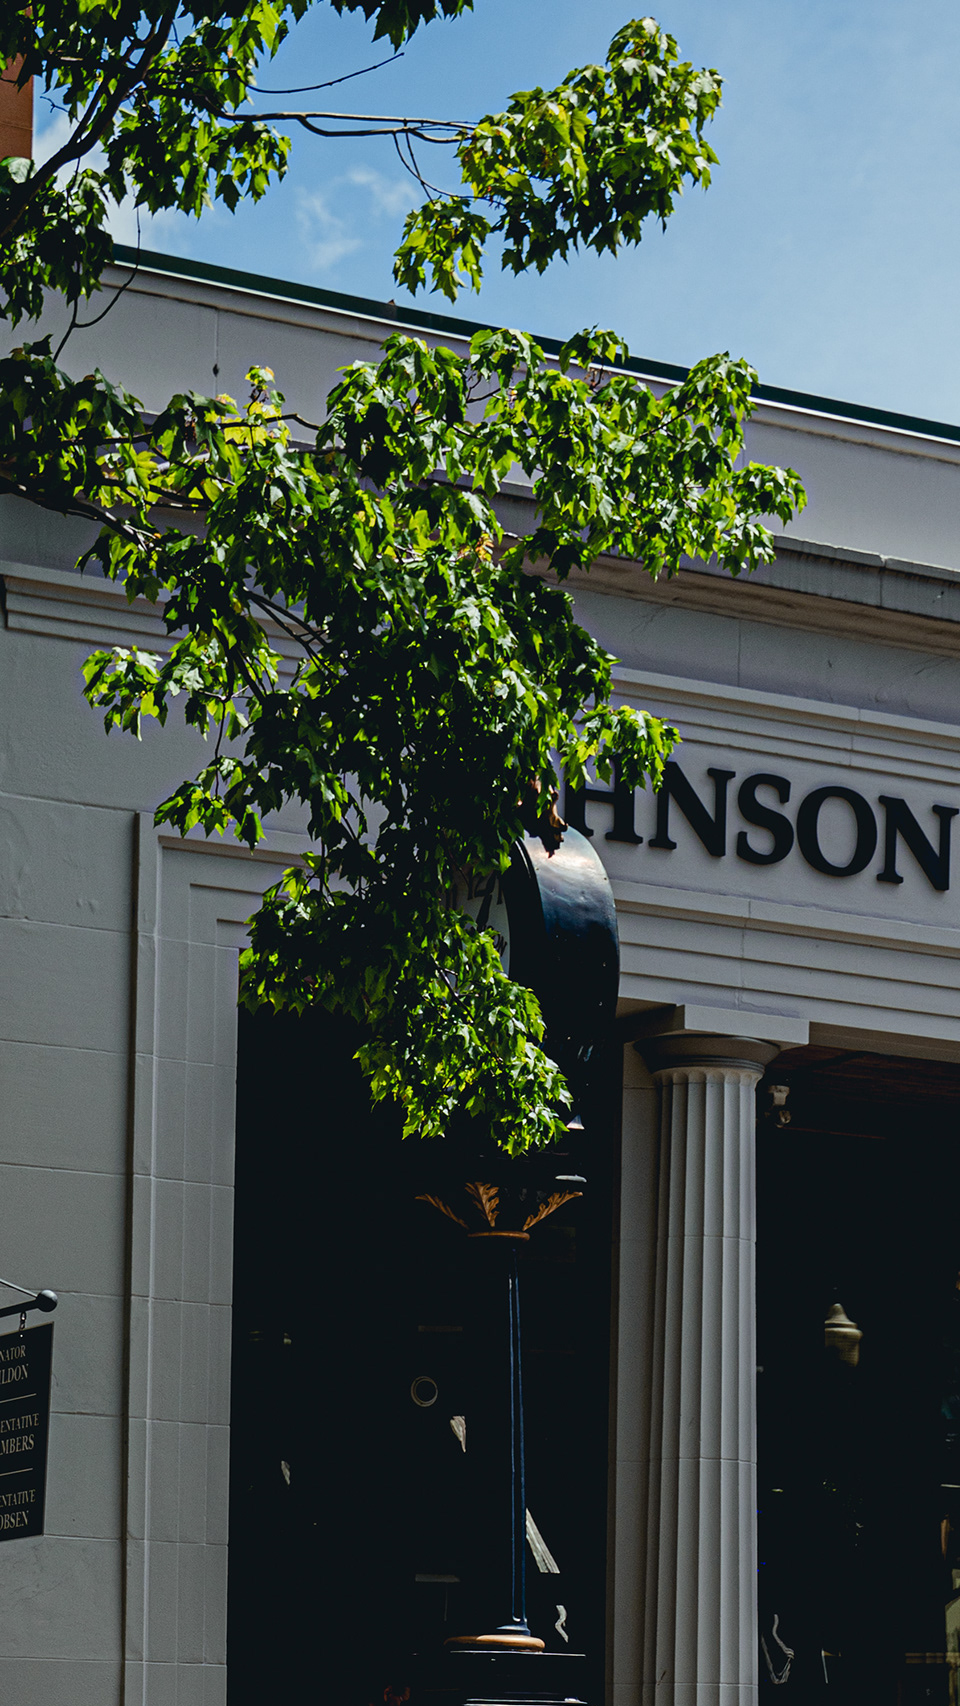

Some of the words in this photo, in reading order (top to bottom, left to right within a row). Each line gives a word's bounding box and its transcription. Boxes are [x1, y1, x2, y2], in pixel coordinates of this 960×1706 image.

[564, 753, 960, 891] HNSON
[0, 1345, 26, 1361] NATOR
[0, 1364, 29, 1384] LDON
[0, 1413, 40, 1433] ENTATIVE
[0, 1434, 35, 1455] MBERS
